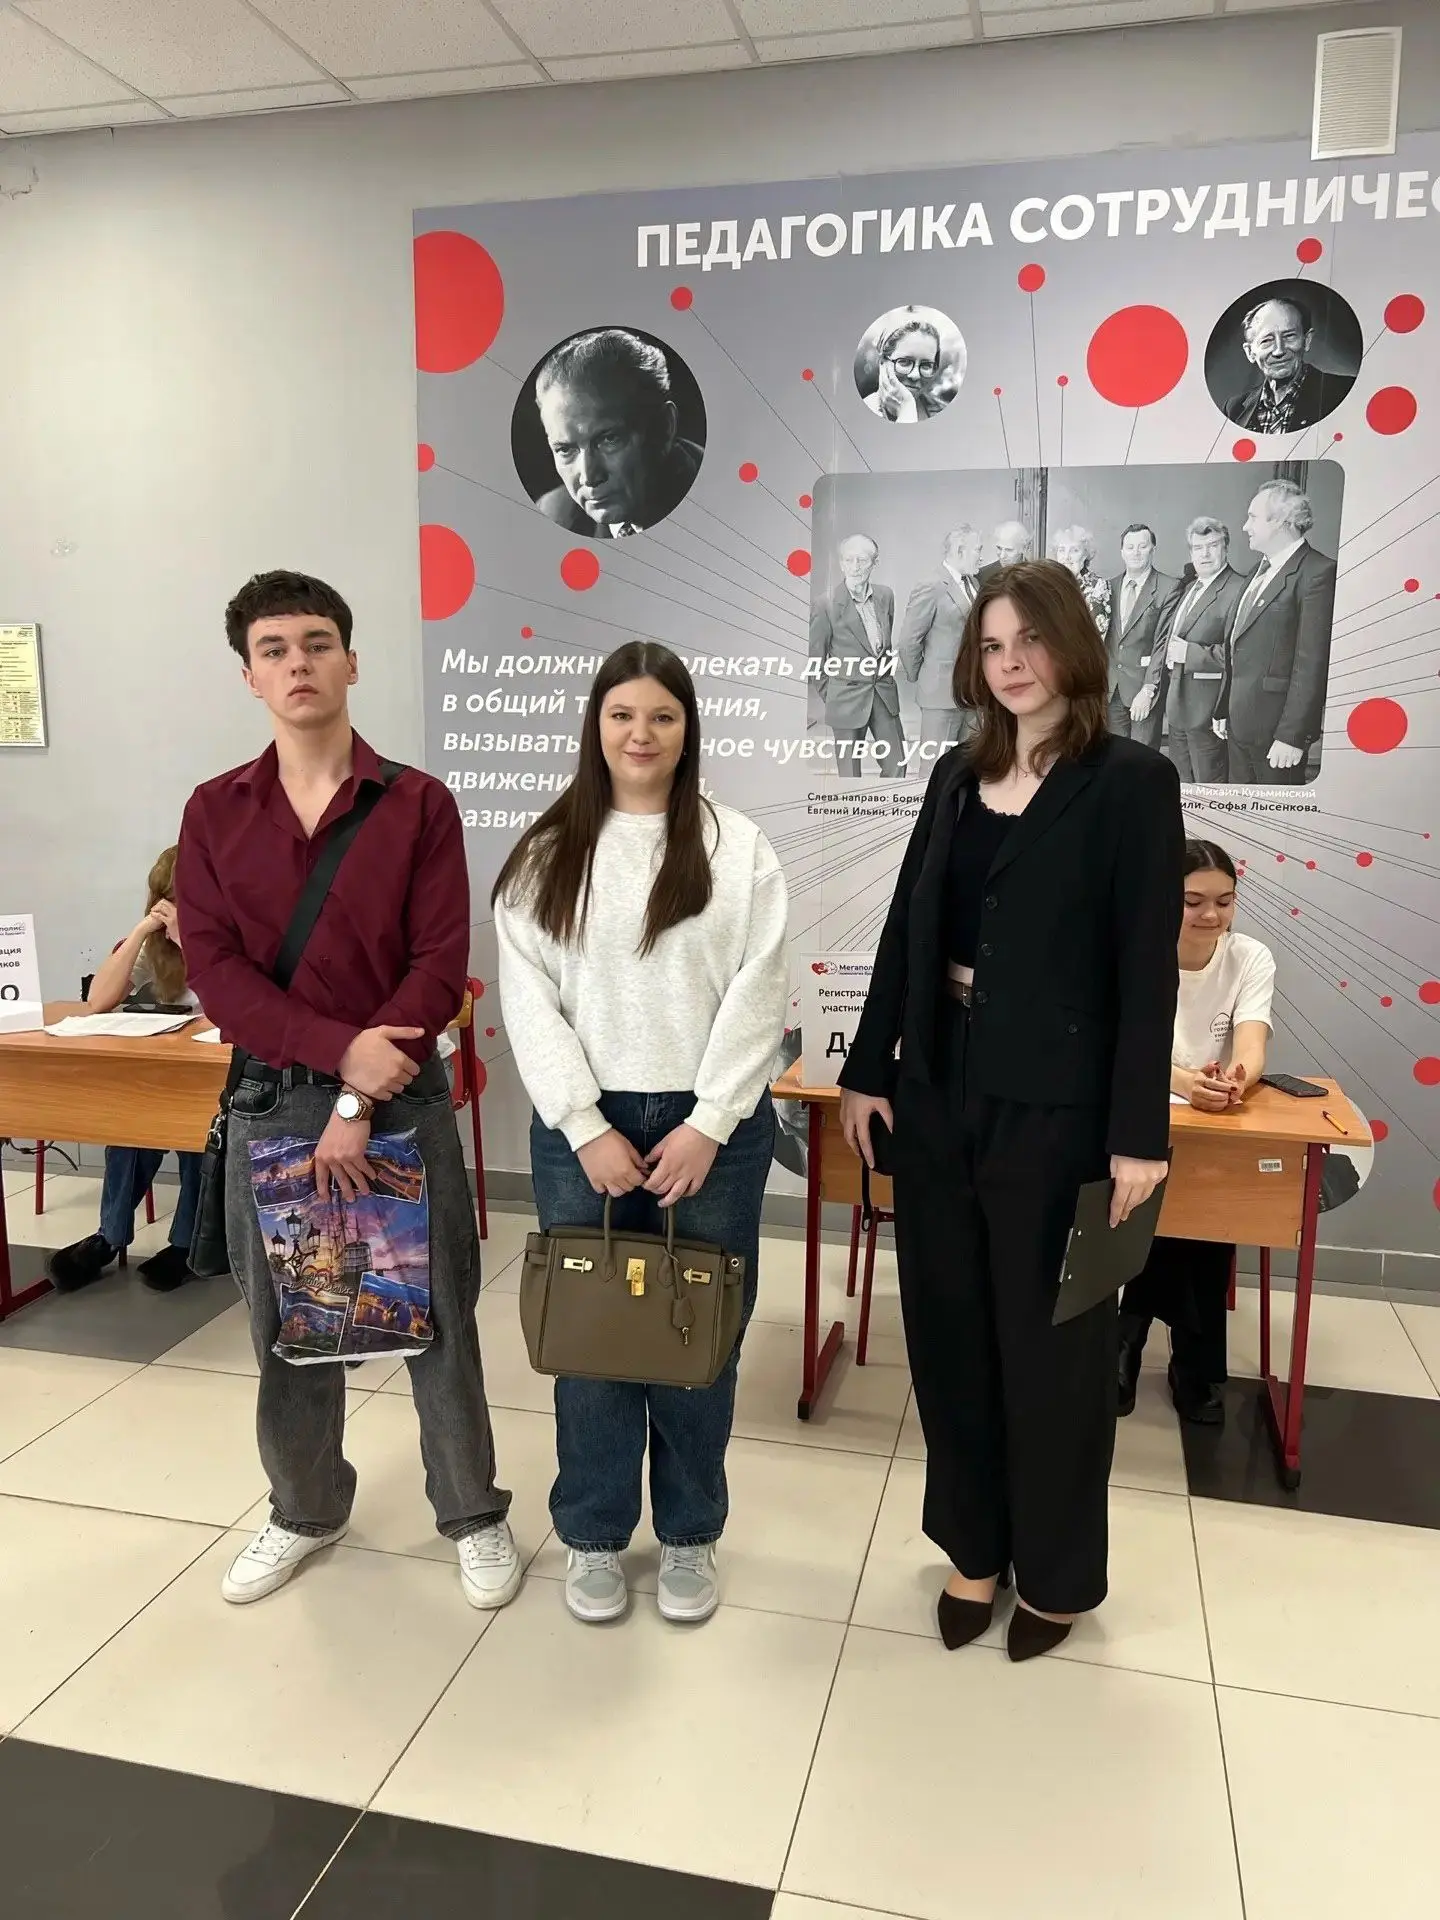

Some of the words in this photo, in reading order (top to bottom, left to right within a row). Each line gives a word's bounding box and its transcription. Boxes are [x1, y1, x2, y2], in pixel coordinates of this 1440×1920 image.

[637, 202, 994, 271] ПЕДАГОГИКА
[1009, 170, 1440, 244] СОТРУДНИЧЕ
[441, 648, 489, 674] Мы
[800, 649, 899, 681] детей
[442, 694, 458, 713] в
[466, 687, 567, 717] общий
[443, 733, 582, 754] вызывать
[699, 739, 755, 758] ное
[763, 740, 891, 765] чувство
[446, 771, 574, 793] движени
[807, 792, 839, 802] Слева
[842, 794, 889, 804] направо:
[1195, 787, 1238, 797] Михаил
[1242, 787, 1317, 799] Кузьминский
[458, 809, 545, 829] азвит
[807, 806, 849, 815] Евгений
[852, 807, 889, 817] Ильин,
[892, 808, 921, 818] Игор
[1209, 800, 1247, 812] Софья
[1251, 801, 1321, 813] Лысенкова,
[818, 989, 868, 998] Регистрац
